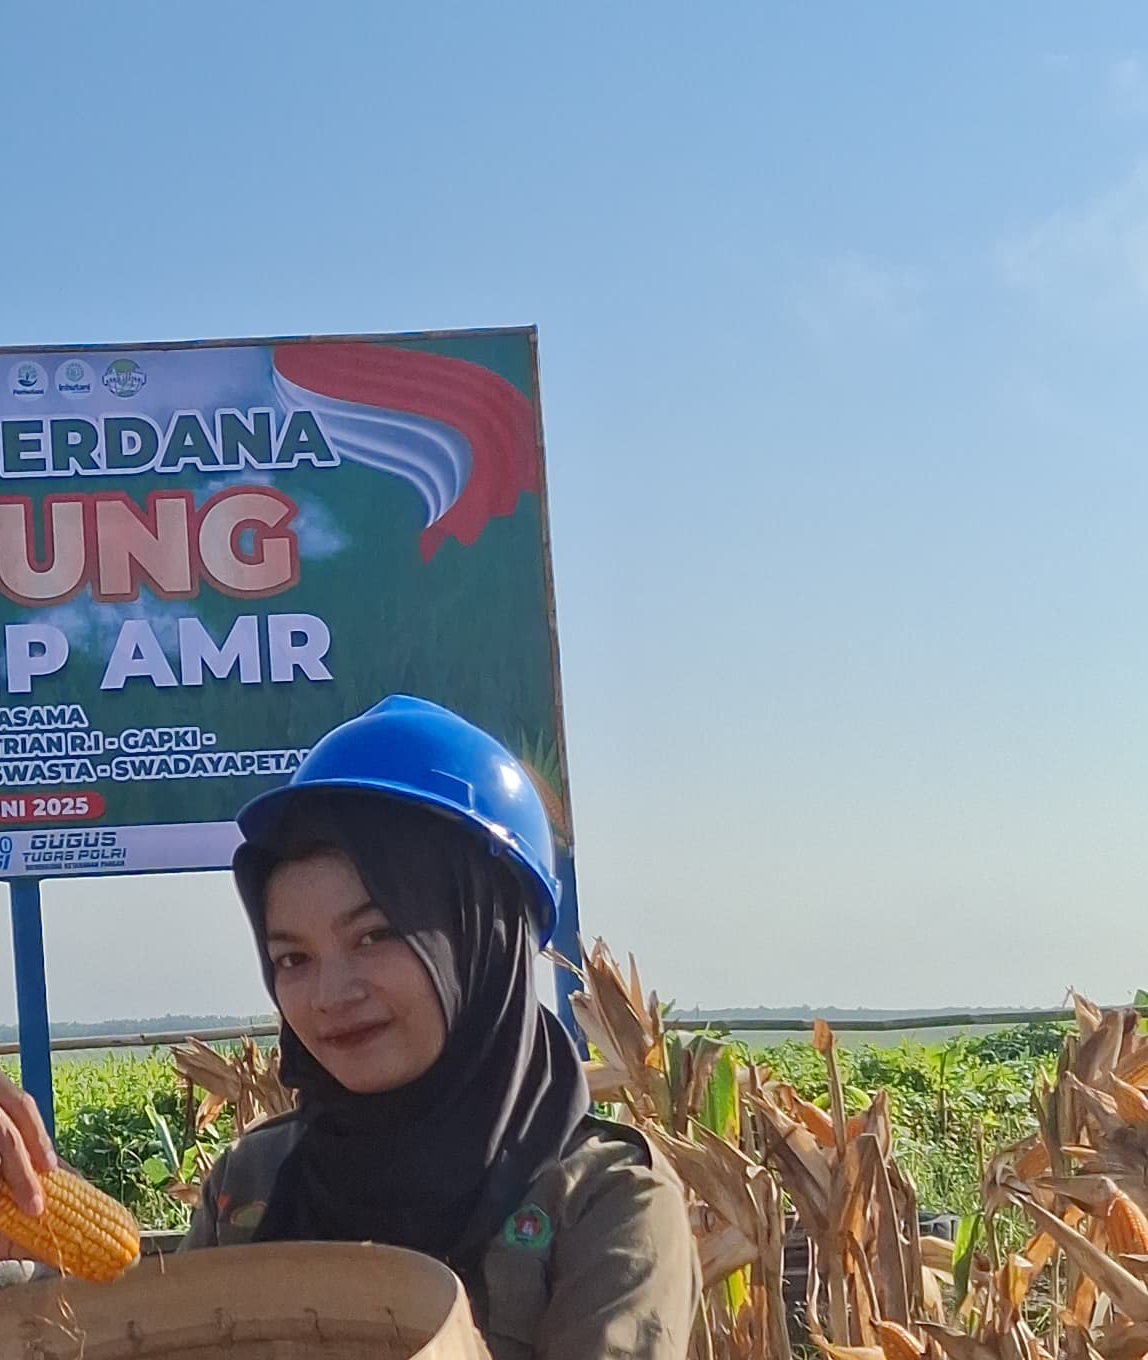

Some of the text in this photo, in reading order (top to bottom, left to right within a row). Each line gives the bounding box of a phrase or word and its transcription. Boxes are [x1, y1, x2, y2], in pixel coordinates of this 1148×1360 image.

[100, 613, 334, 691] AMR
[119, 727, 201, 753] GAPKI
[112, 749, 311, 781] SWADAYAPETA
[32, 796, 90, 818] 2025
[30, 831, 117, 850] GUGUS
[22, 847, 127, 863] TUGAS POLRI
